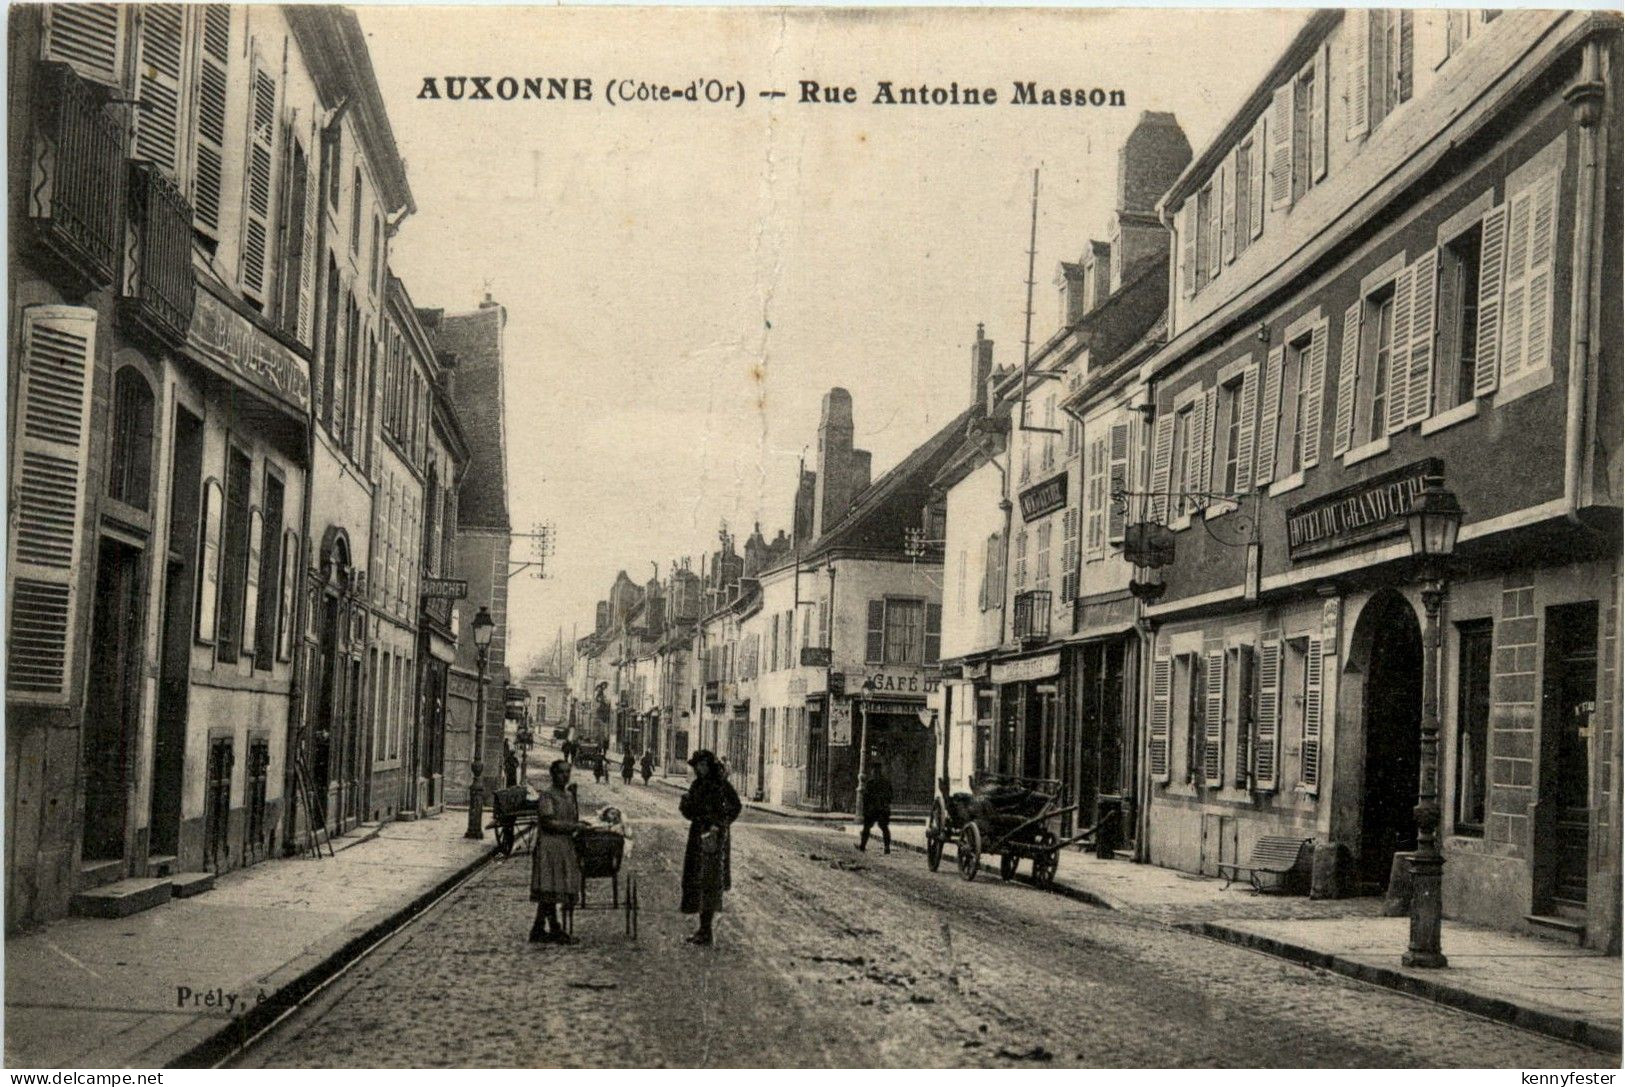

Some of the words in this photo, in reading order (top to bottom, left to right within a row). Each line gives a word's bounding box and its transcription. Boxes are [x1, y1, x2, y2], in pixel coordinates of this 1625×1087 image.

[1323, 504, 1341, 537] DU
[1341, 488, 1386, 531] GRAND
[421, 581, 467, 597] BROCHET
[873, 671, 918, 692] CAFÉ
